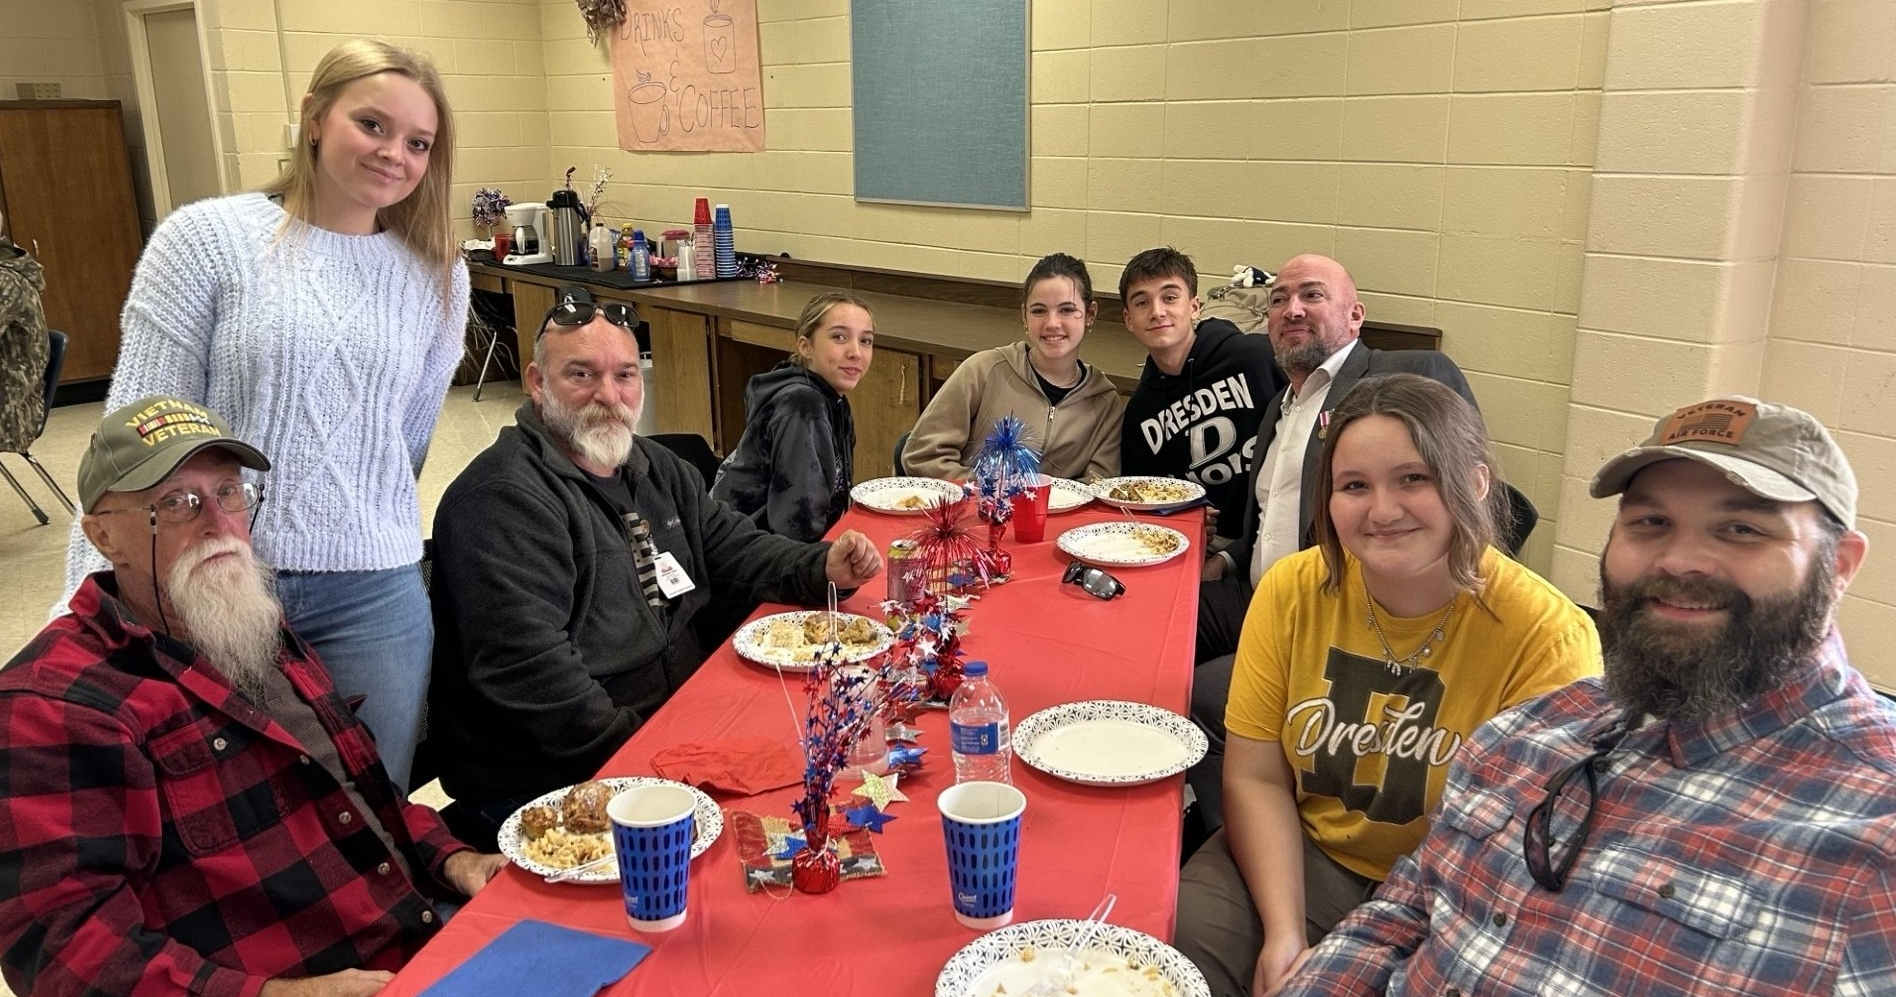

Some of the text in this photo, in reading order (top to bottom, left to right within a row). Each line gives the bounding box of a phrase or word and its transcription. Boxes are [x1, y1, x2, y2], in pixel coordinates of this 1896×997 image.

[620, 4, 684, 56] DRINKS
[679, 84, 760, 133] COFFEE
[126, 400, 208, 428] VIETNAM
[1140, 372, 1255, 455] DRESDEN
[1677, 404, 1746, 418] VETERAN
[143, 423, 220, 446] VETERAN
[1668, 428, 1734, 440] AIR FORCE
[1287, 697, 1462, 767] Dresden
